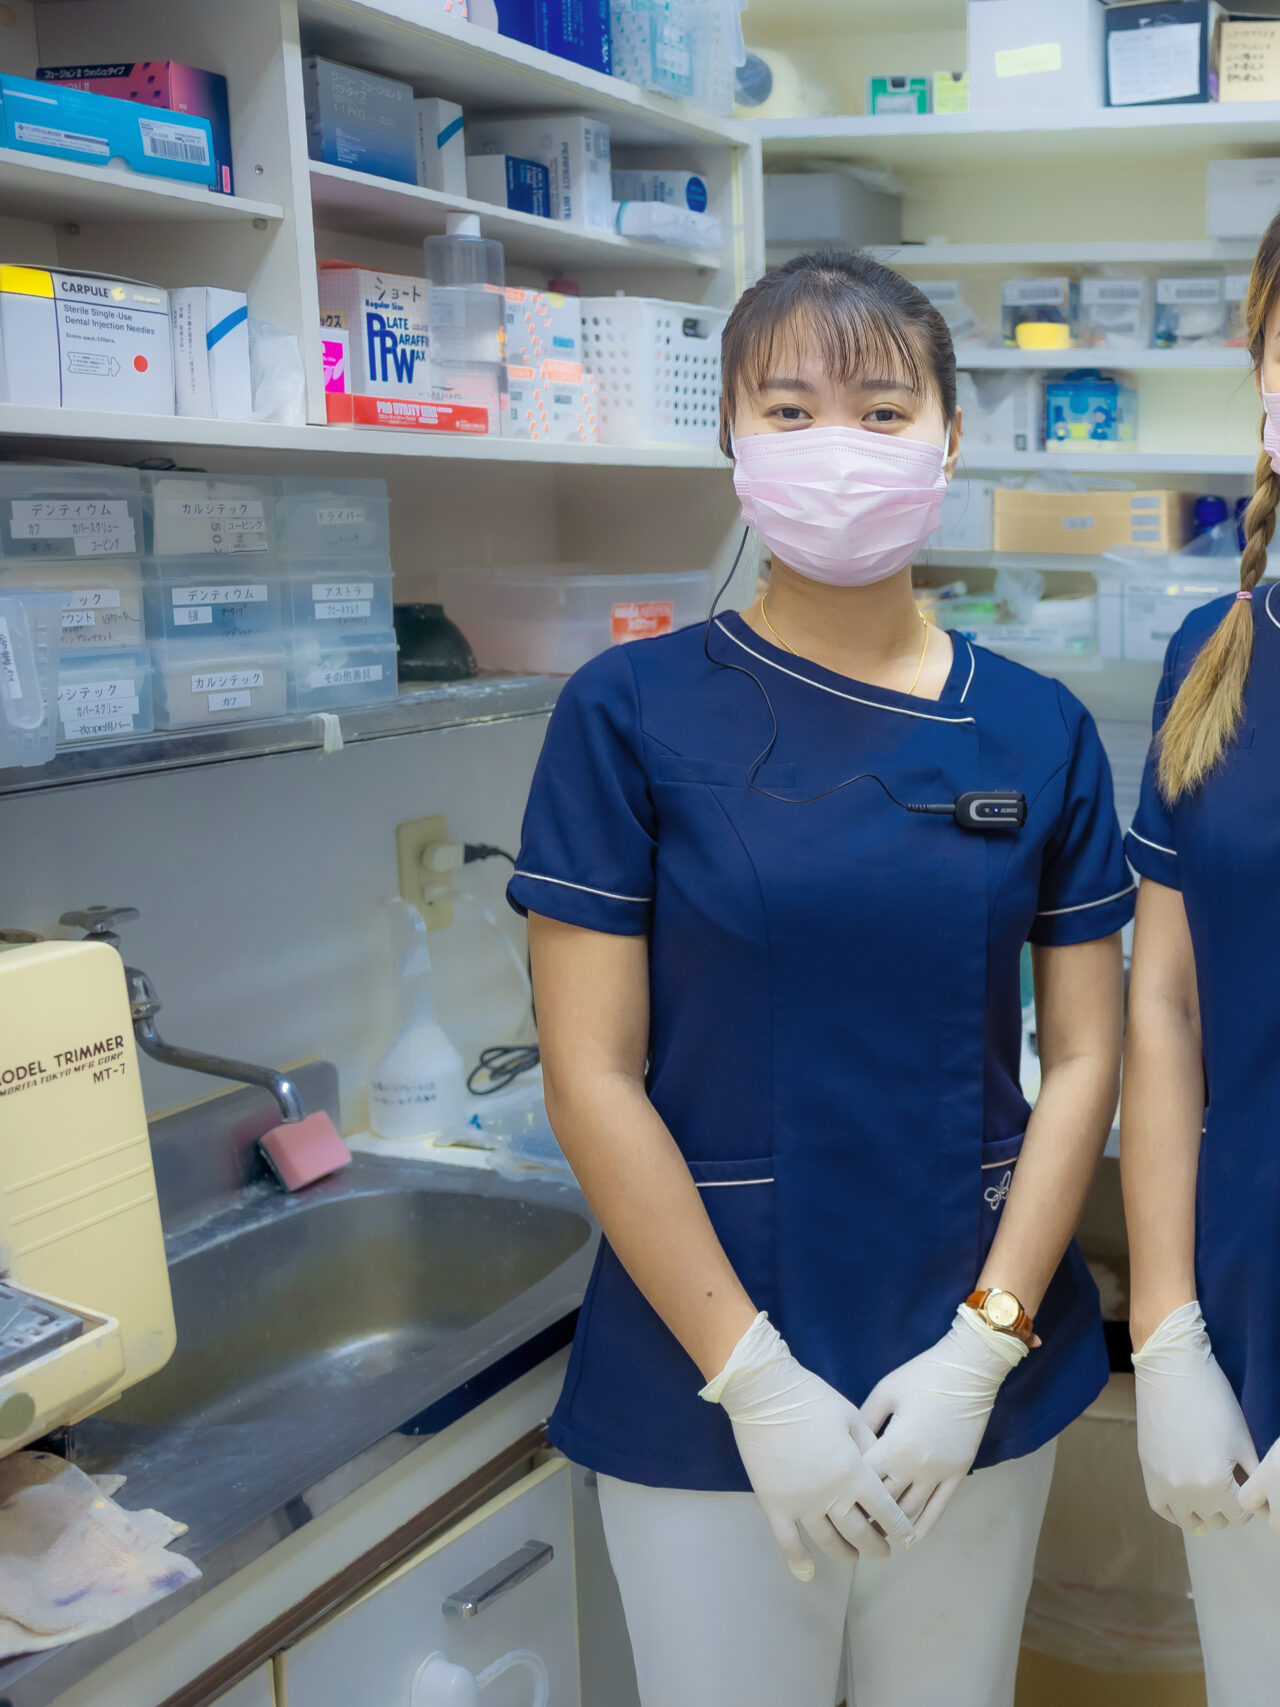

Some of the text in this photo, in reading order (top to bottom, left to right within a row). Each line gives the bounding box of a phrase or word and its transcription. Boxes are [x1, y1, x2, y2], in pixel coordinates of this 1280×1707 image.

[61, 282, 109, 298] CARPULE
[64, 304, 132, 321] Sterile Single-Use
[365, 299, 390, 310] Regular
[65, 316, 156, 335] Dental Injection Needles
[31, 503, 112, 517] デンティウム
[182, 503, 248, 515] カルシテック
[188, 588, 254, 602] デンティウム
[325, 585, 361, 598] アストラ
[195, 672, 260, 689] カルシテック
[0, 1035, 125, 1086] ODEL TRIMMER
[0, 1051, 124, 1097] MORITA TOKYO MFG CORP
[93, 1063, 126, 1085] MT-7
